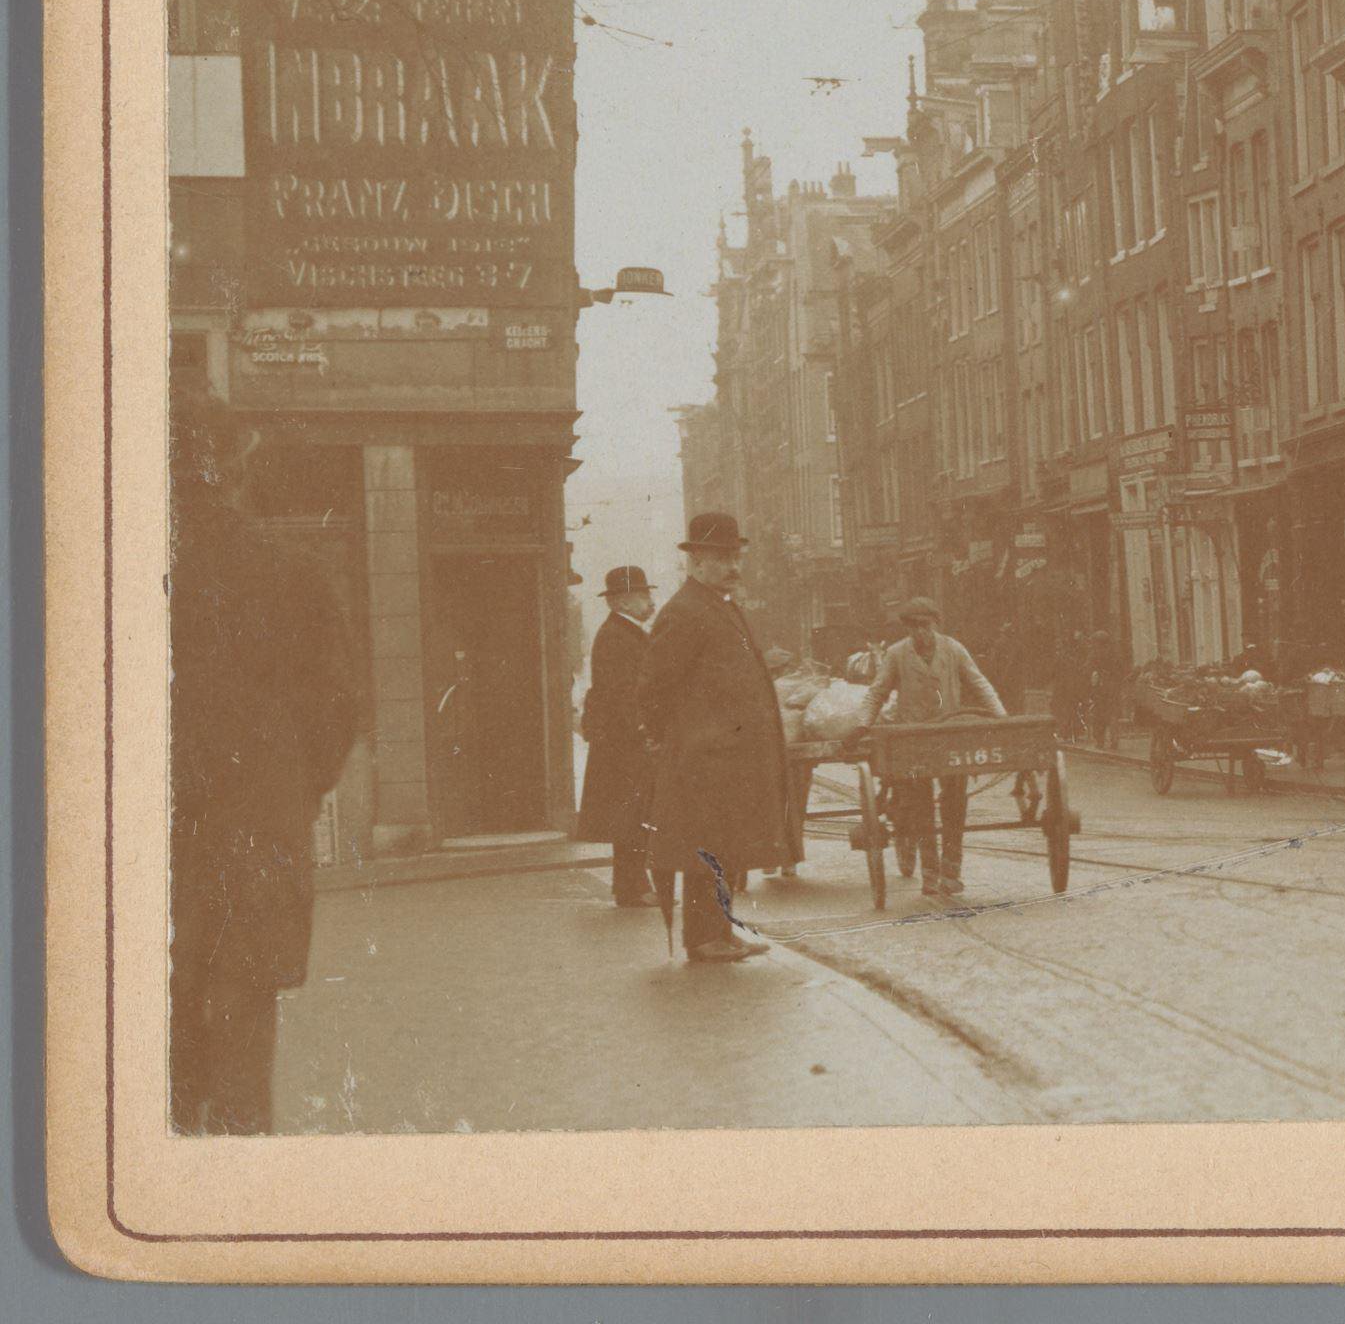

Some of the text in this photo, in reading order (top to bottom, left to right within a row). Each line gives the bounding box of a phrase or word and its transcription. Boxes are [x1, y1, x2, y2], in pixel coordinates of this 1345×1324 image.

[258, 40, 558, 153] INBRAAK
[271, 174, 552, 225] FRANZ DISCH
